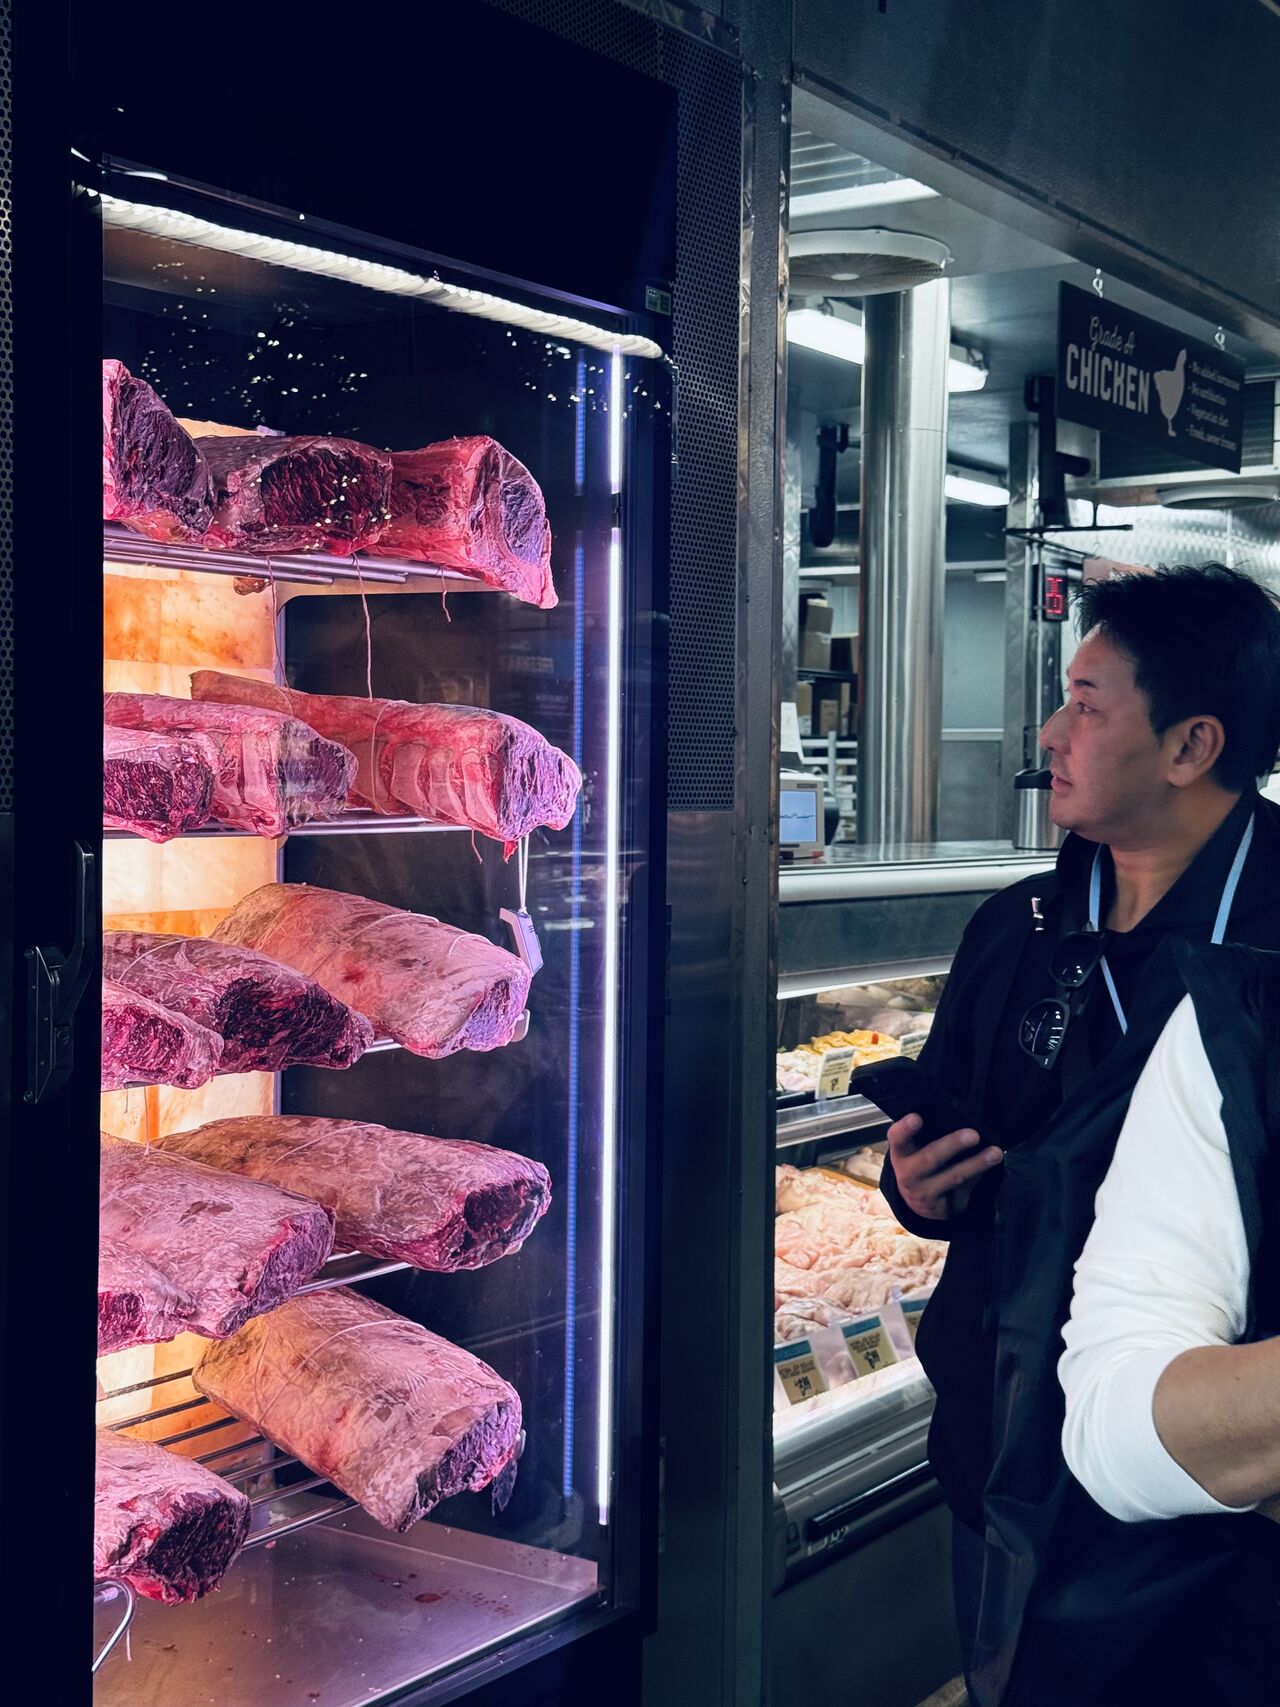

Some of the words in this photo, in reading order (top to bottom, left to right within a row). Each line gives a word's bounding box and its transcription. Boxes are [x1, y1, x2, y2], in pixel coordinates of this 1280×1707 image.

[1089, 316, 1122, 352] Grade
[1123, 331, 1136, 355] A
[1065, 343, 1150, 415] CHICKEN
